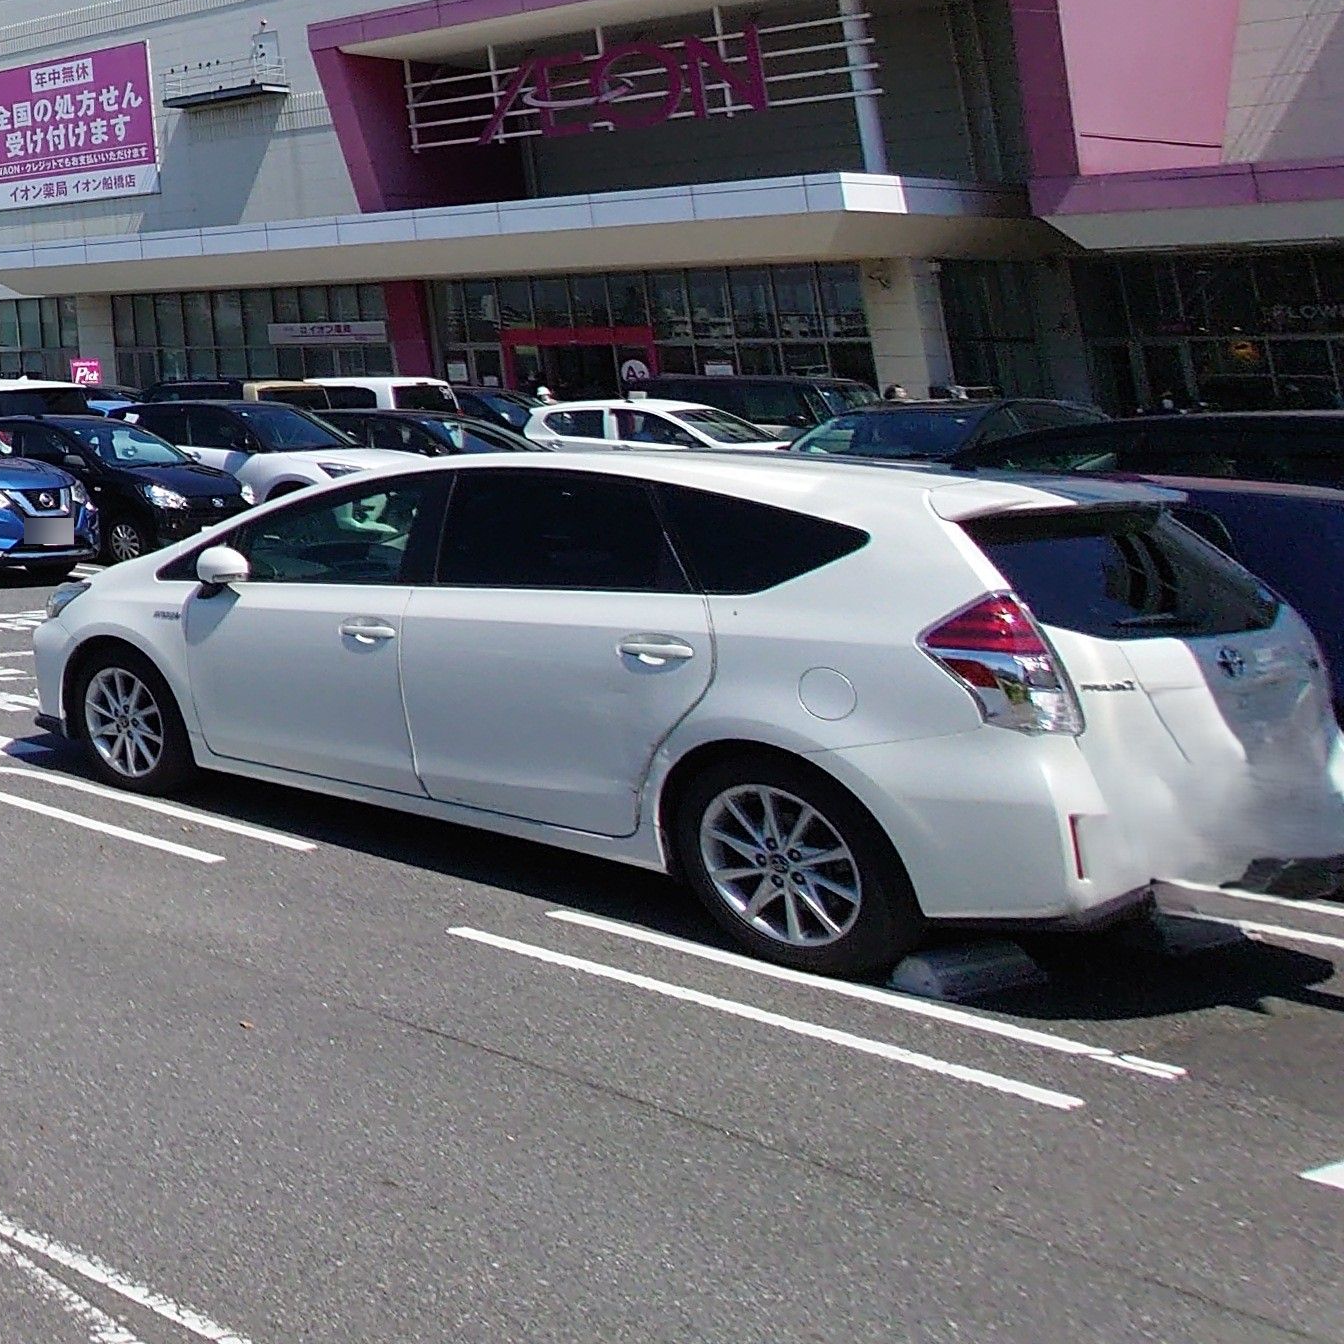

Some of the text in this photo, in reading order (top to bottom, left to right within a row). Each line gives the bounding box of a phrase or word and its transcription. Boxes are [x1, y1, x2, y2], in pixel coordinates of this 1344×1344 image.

[34, 62, 89, 88] 年中無休
[5, 114, 131, 158] 受け付けます
[9, 174, 137, 203] イオン薬局 イオン船橋店
